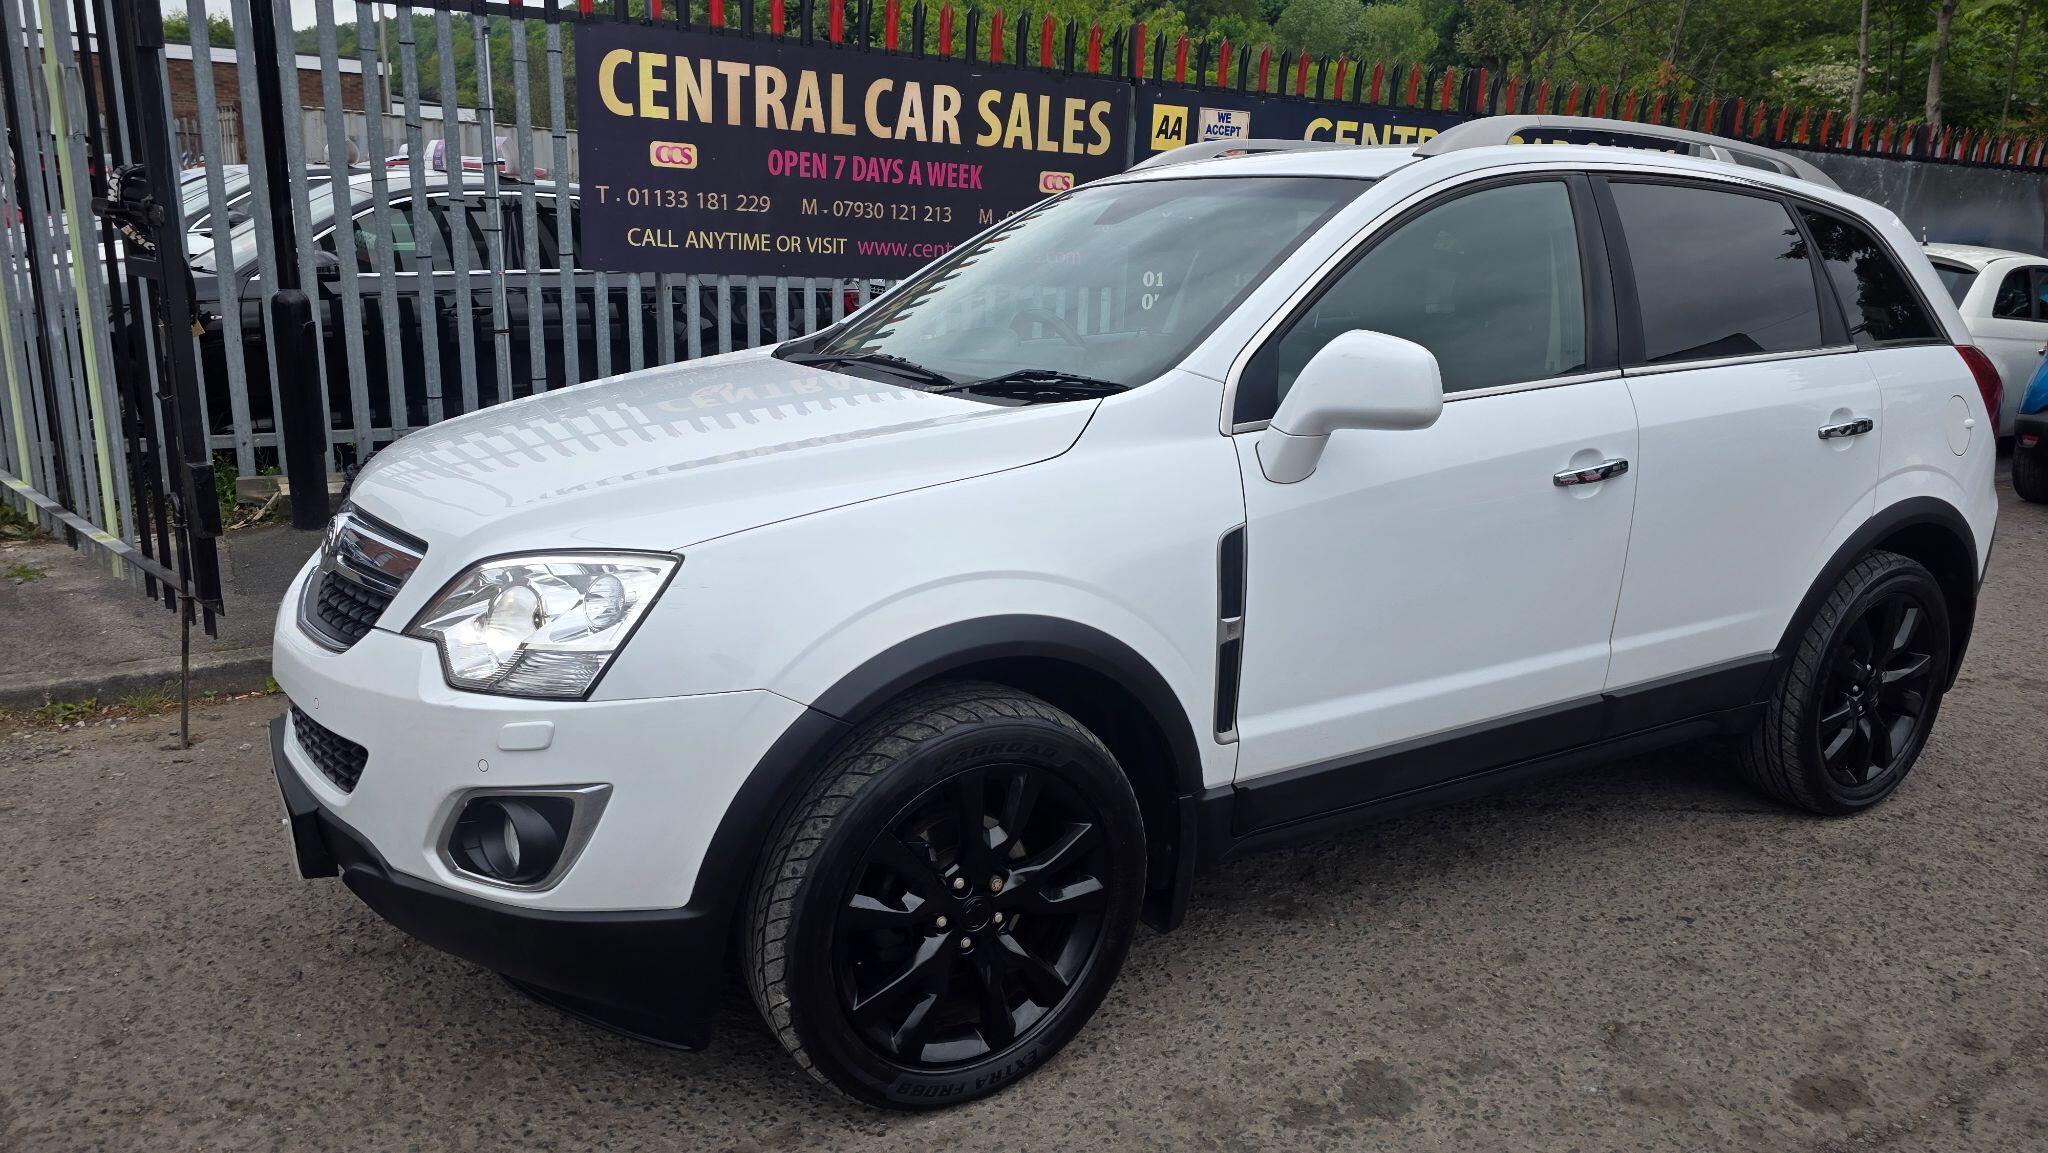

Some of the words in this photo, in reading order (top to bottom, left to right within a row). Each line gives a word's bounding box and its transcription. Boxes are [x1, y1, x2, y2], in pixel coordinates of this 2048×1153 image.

[598, 48, 857, 137] CENTRAL
[864, 77, 962, 145] CAR
[976, 89, 1112, 156] SALES
[1155, 115, 1183, 141] AA
[1217, 112, 1232, 124] WE
[1205, 124, 1241, 137] ACCEPT
[655, 145, 693, 165] CCS
[767, 149, 827, 179] OPEN
[833, 155, 846, 180] 7
[852, 155, 904, 184] DAYS
[908, 161, 923, 186] A
[926, 161, 983, 190] WEEK
[627, 187, 688, 209] 01133
[697, 192, 728, 211] 181
[736, 194, 771, 213] 229
[833, 200, 884, 219] 07930
[890, 203, 916, 221] 121
[924, 206, 952, 222] 213
[627, 228, 679, 248] CALL
[685, 230, 771, 252] ANYTIME
[776, 235, 802, 253] OR
[807, 236, 848, 254] VISIT
[857, 240, 955, 258] www.cent
[1142, 271, 1164, 287] 01
